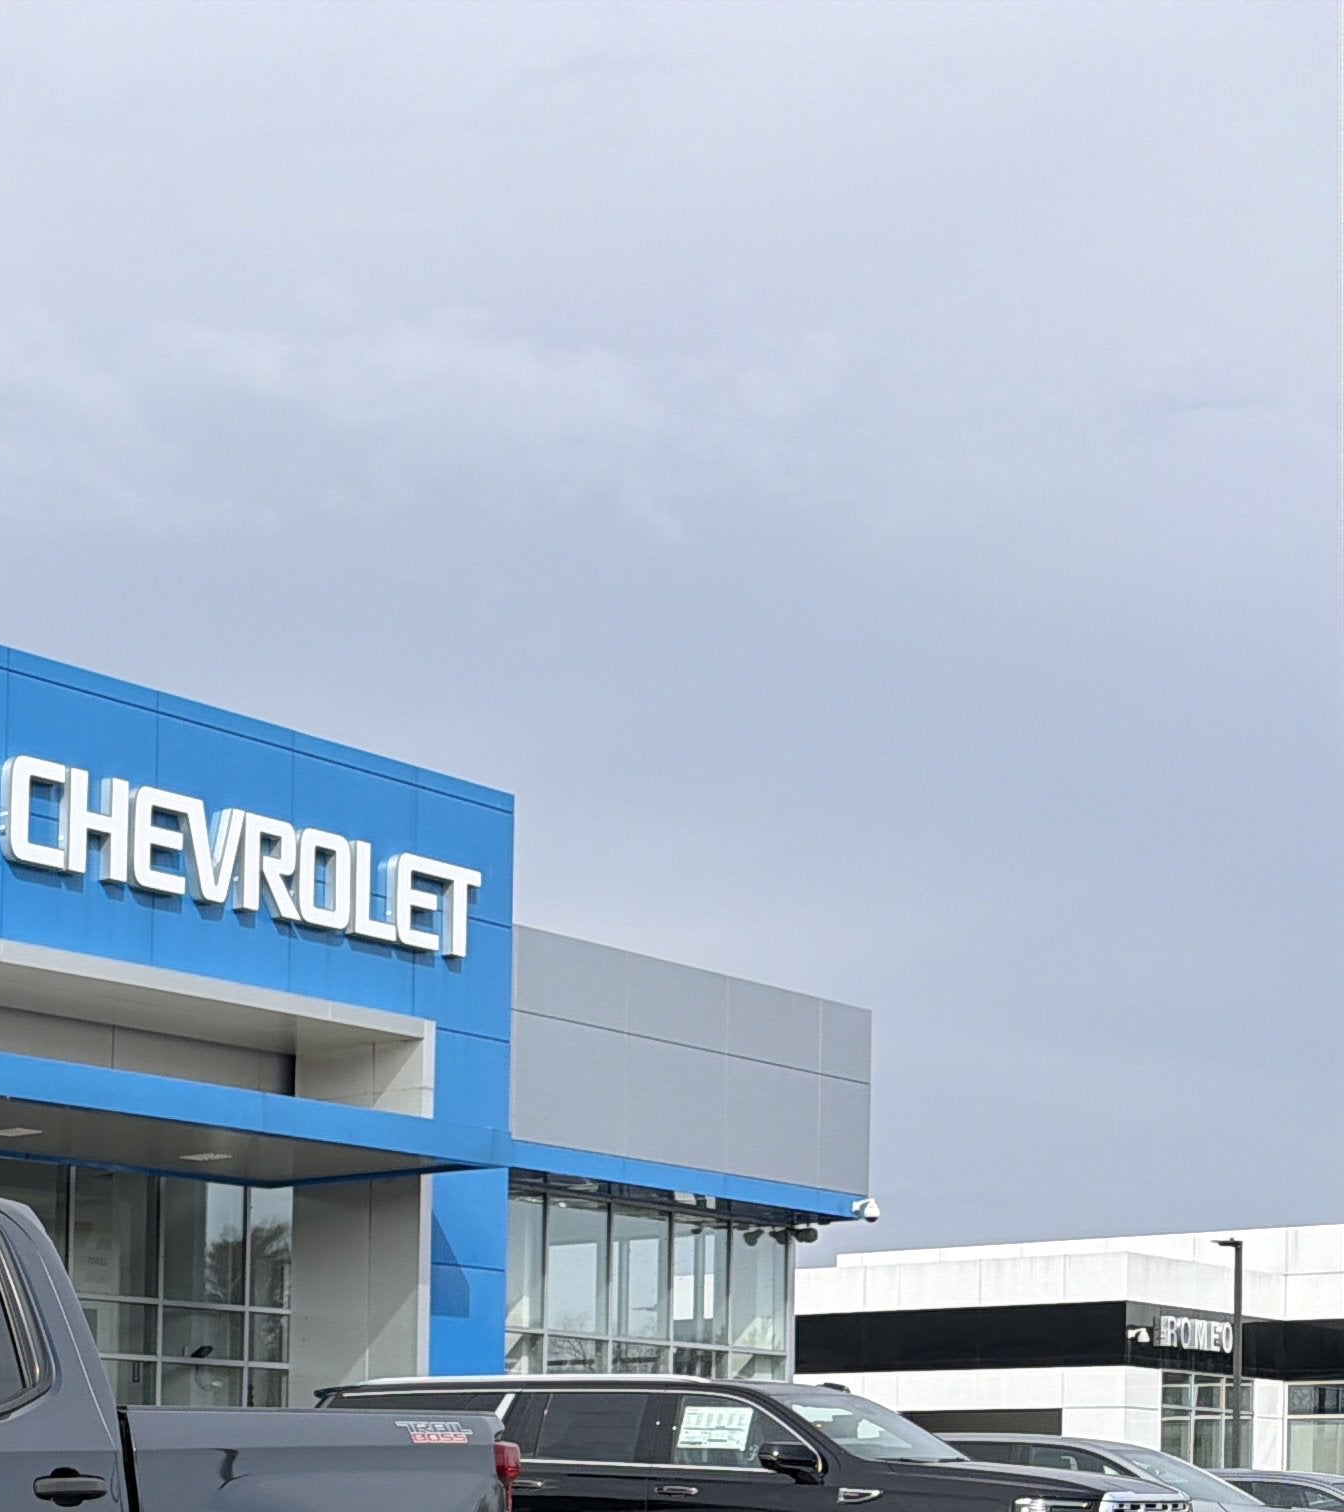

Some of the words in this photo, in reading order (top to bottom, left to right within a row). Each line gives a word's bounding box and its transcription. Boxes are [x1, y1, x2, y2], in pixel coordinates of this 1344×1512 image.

[0, 755, 481, 958] CHEVROLET
[1160, 1315, 1233, 1353] ROMEO
[395, 1420, 473, 1435] TRAIL
[410, 1432, 468, 1444] BOSS
